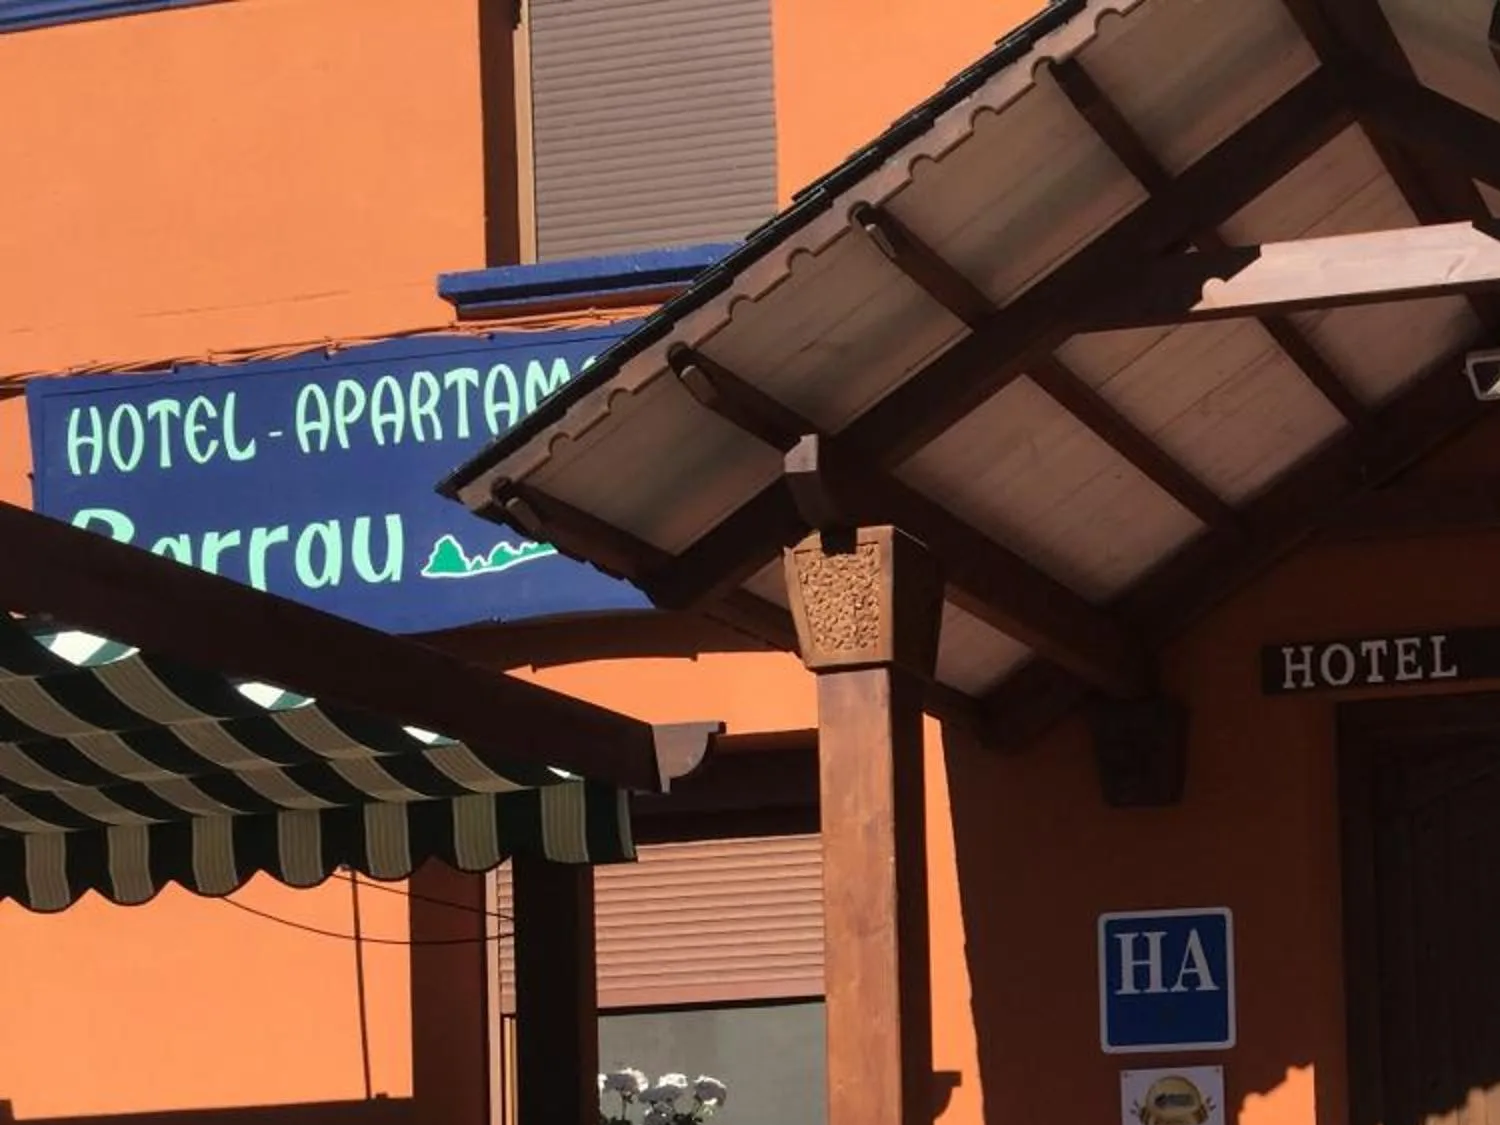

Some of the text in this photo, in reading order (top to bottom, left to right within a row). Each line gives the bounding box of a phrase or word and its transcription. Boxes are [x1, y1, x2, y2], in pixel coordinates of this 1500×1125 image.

[66, 391, 257, 476] HOTEL
[295, 355, 597, 453] APARTAM
[1281, 634, 1458, 689] HOTEL
[1113, 927, 1221, 995] HA
